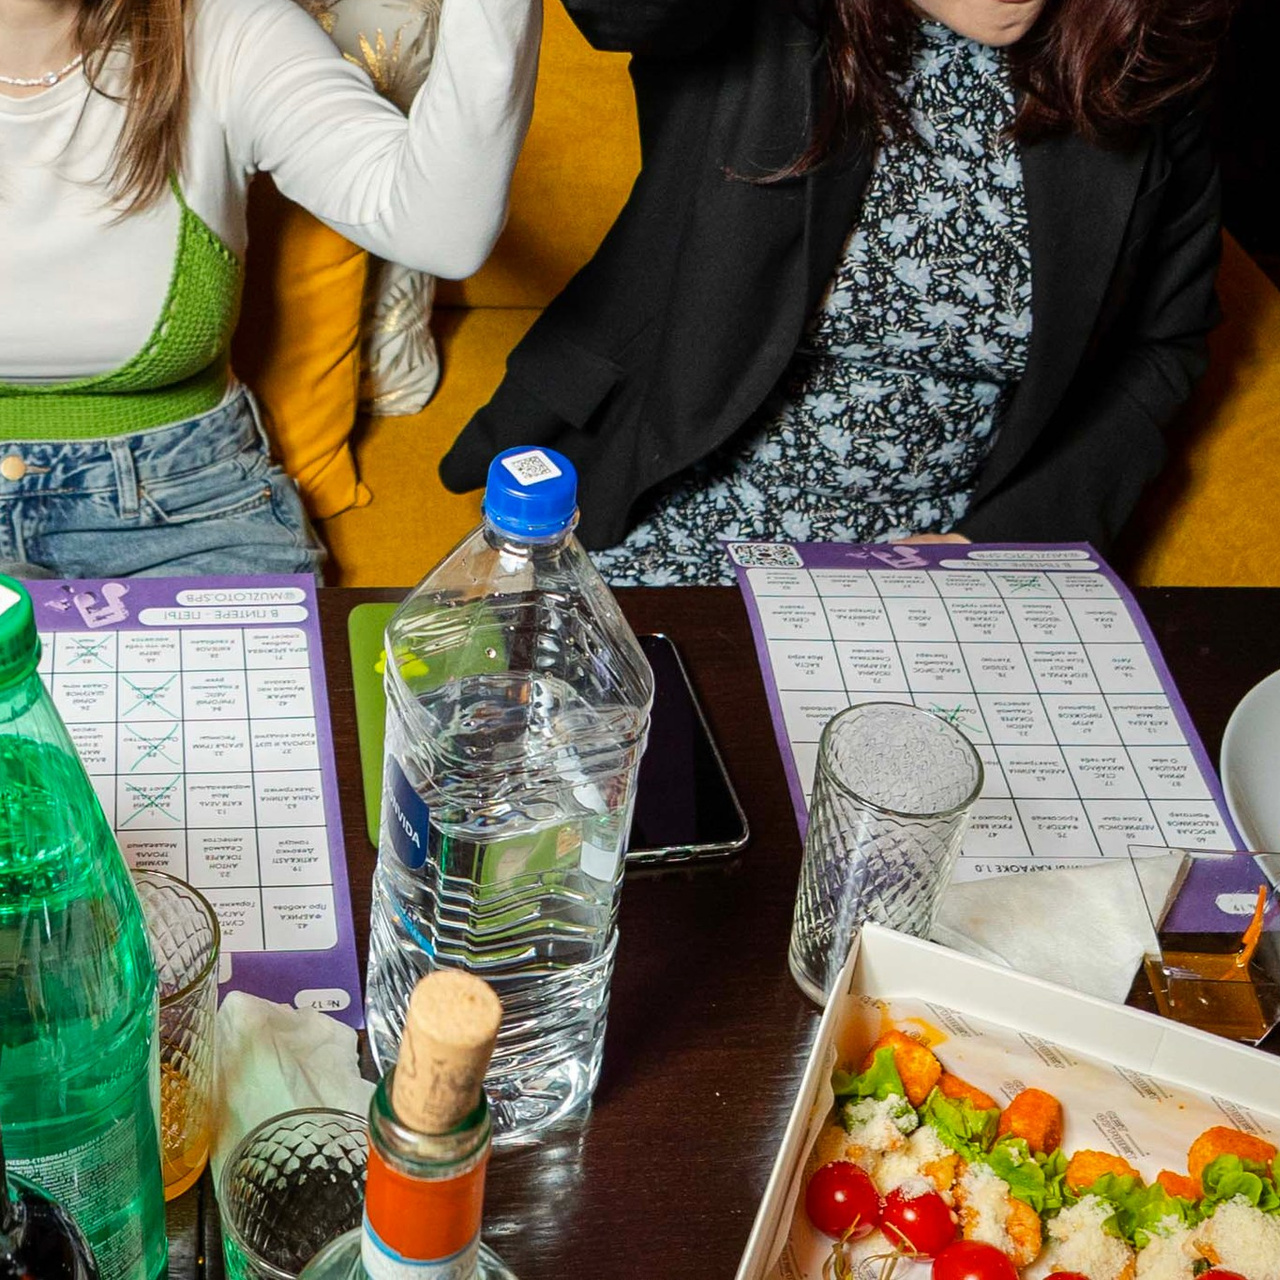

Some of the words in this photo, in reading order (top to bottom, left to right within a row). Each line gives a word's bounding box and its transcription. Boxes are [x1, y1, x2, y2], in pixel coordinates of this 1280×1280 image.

[186, 591, 296, 604] @MUZLOTO.SPB
[163, 610, 201, 621] ПЕТЬ!
[215, 609, 266, 620] ПИТЕРЕ
[270, 608, 279, 619] В
[975, 864, 992, 873] 1.0
